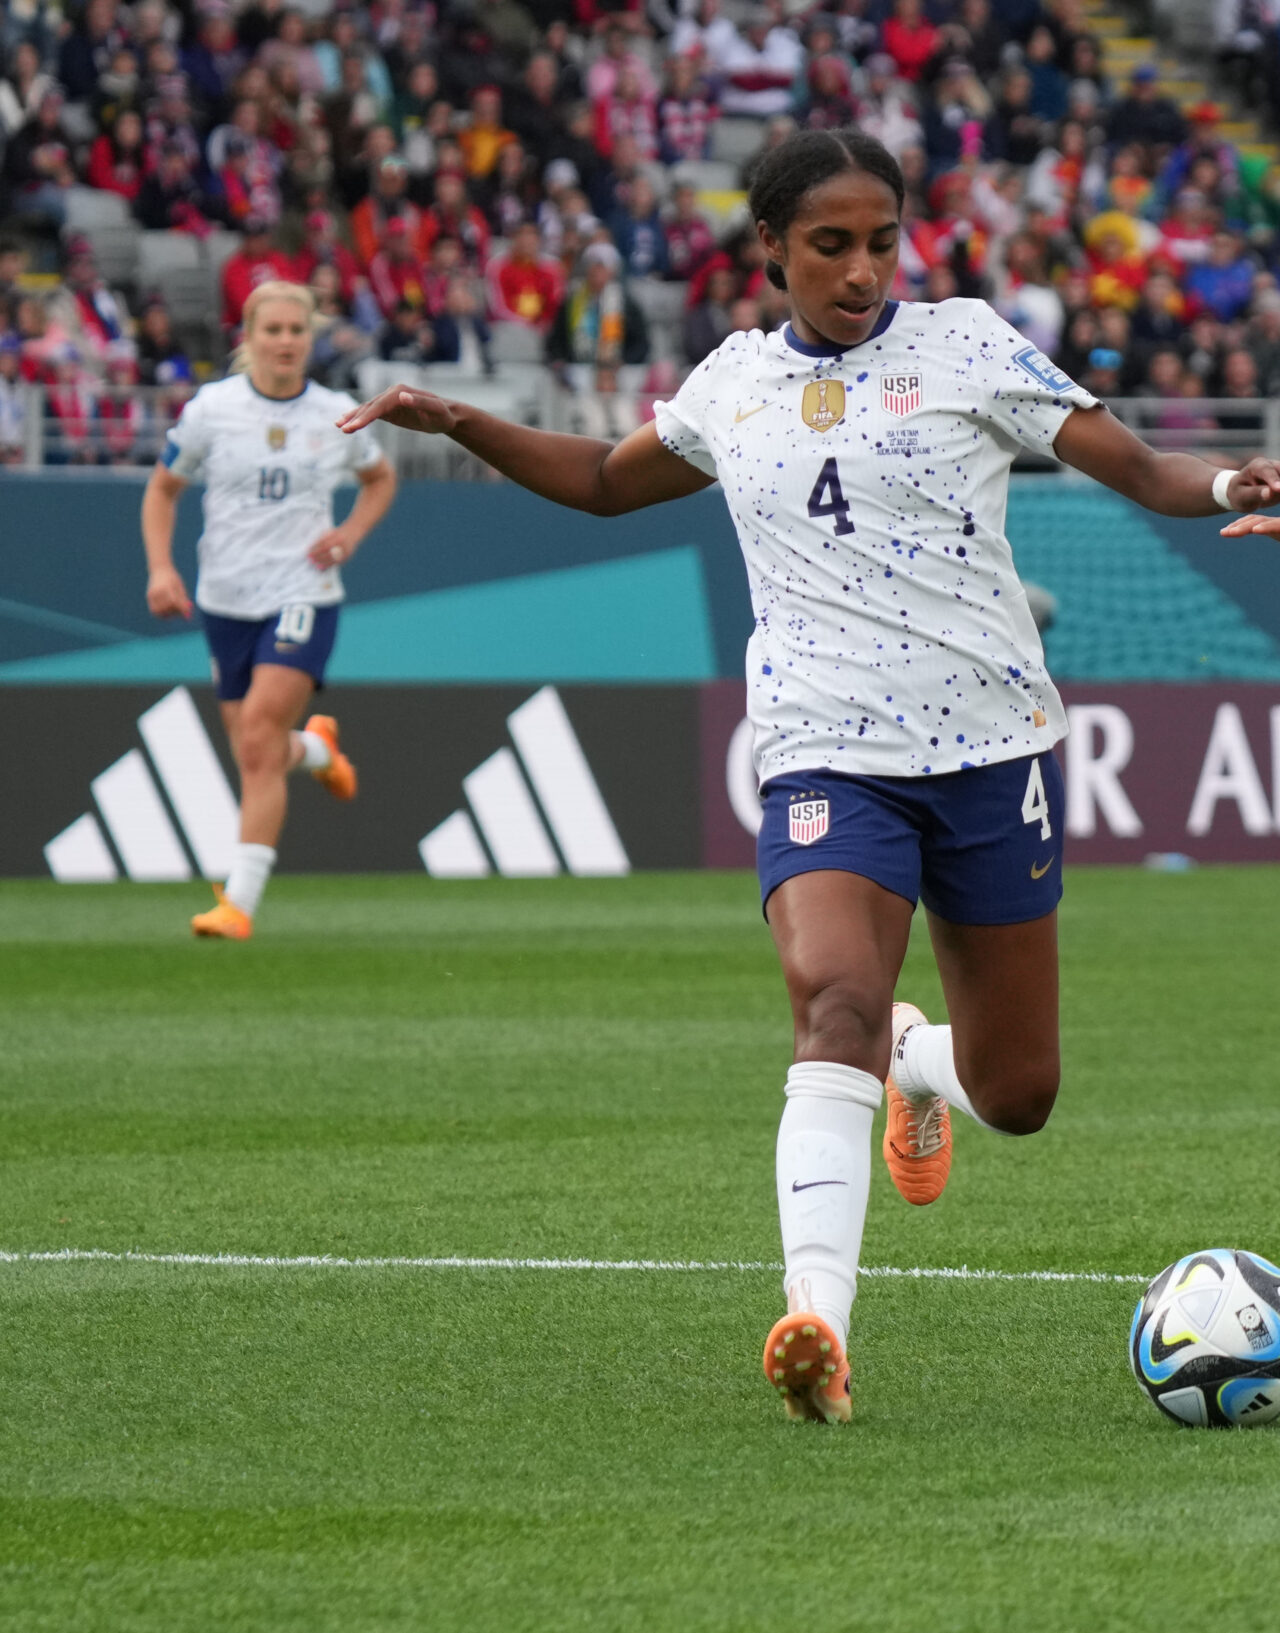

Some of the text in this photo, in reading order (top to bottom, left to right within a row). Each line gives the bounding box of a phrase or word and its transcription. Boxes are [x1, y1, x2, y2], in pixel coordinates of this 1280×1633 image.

[884, 376, 919, 394] USA
[812, 411, 834, 420] FIFA
[256, 466, 290, 500] 10
[807, 457, 856, 536] 4
[275, 603, 316, 644] 10
[792, 803, 826, 821] USA
[1021, 757, 1052, 842] 4
